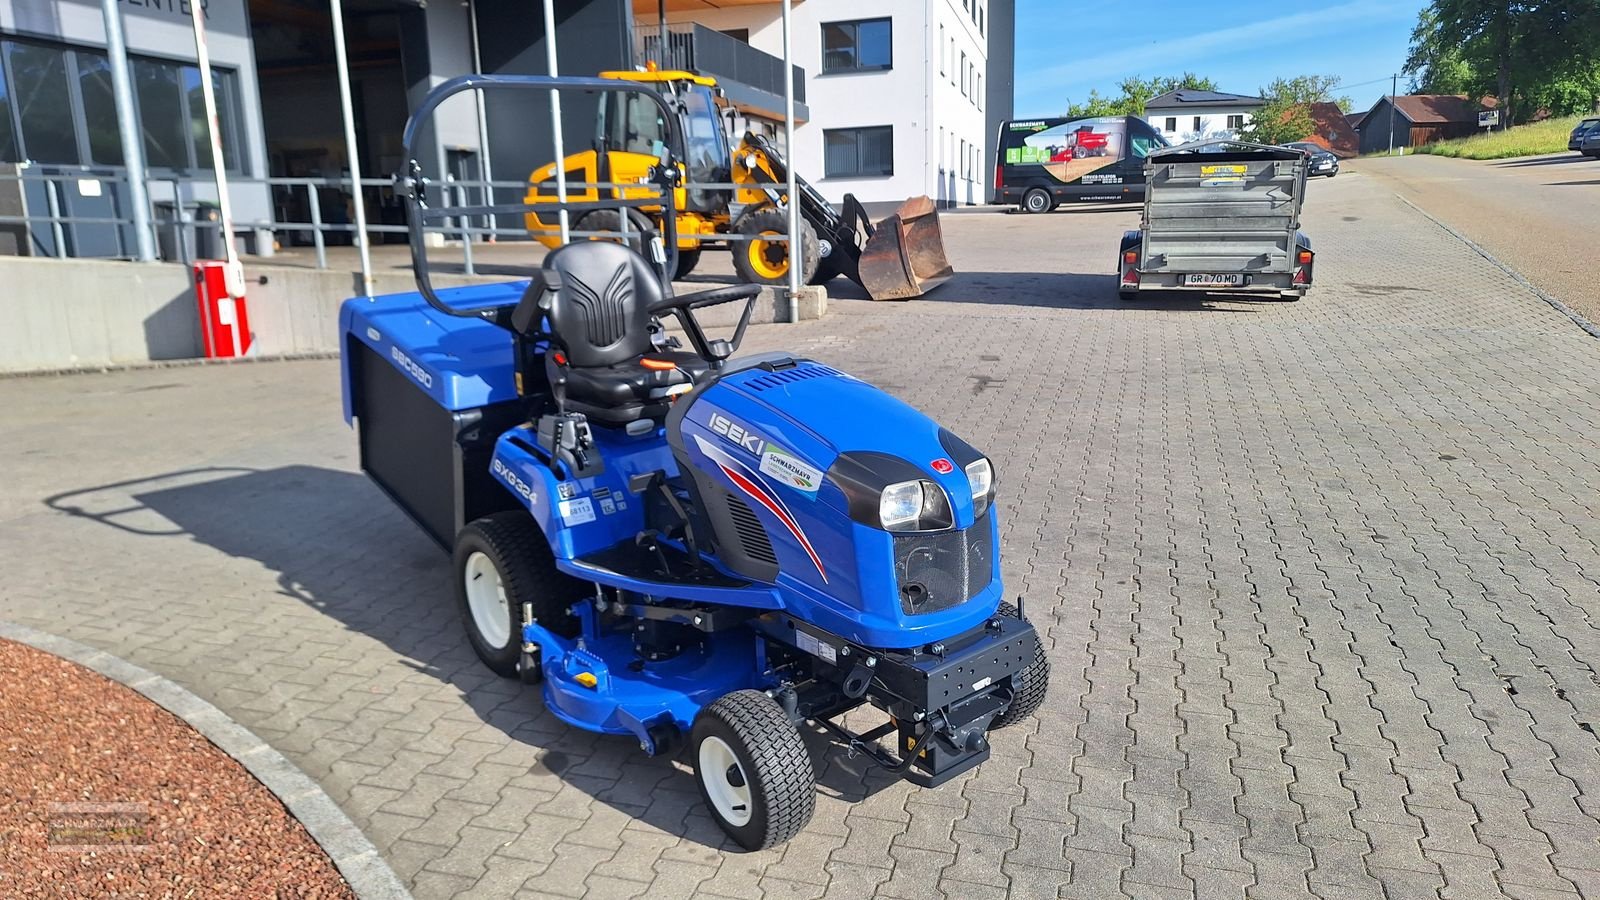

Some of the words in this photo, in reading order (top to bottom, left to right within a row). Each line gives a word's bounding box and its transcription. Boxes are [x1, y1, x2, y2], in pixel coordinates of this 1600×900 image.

[1191, 274, 1202, 283] GR
[1210, 274, 1222, 283] 70
[1225, 274, 1237, 283] MD
[708, 412, 764, 455] ISEKI
[494, 459, 538, 505] SXG324
[769, 453, 811, 481] SCHWARZMAYR
